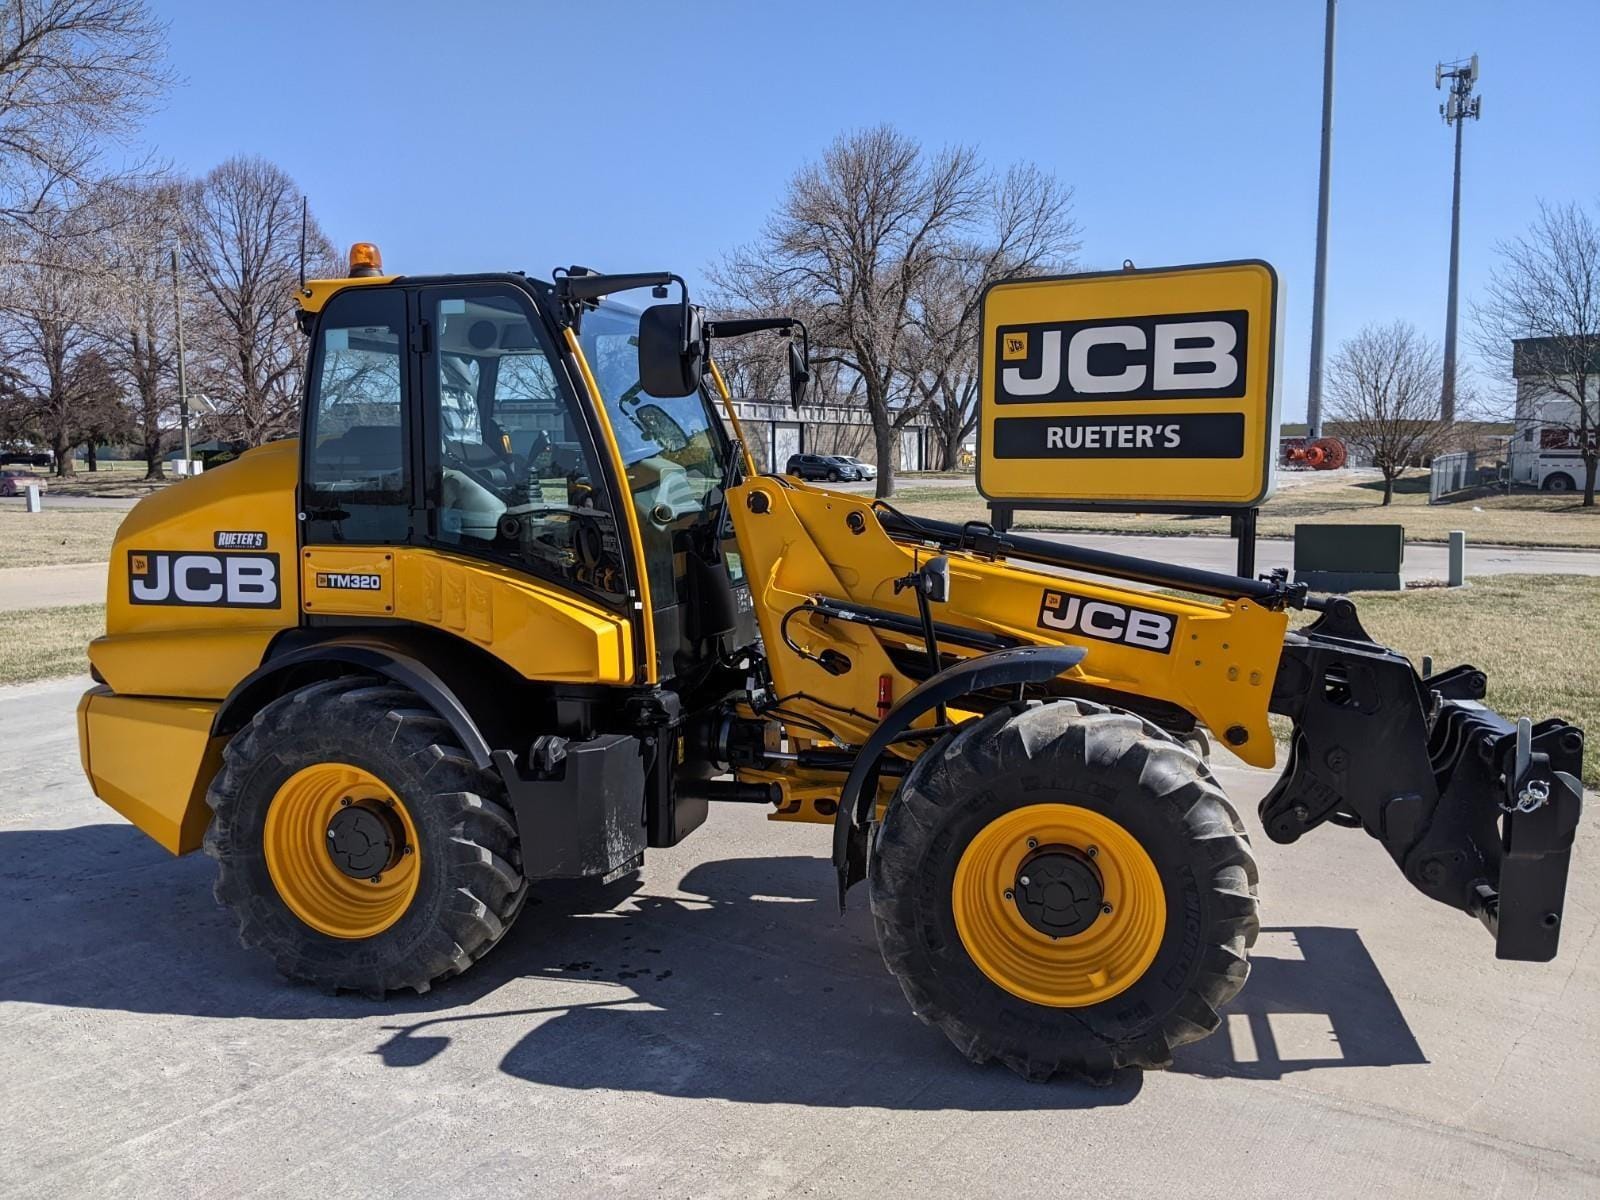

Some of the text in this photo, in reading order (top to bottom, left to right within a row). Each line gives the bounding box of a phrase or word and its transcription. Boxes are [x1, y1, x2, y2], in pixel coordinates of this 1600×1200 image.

[1003, 320, 1238, 396] JCB
[1047, 424, 1181, 449] RUETER'S
[218, 532, 263, 546] RUETER'S
[132, 555, 277, 603] JCB
[328, 574, 380, 589] TM320
[1042, 597, 1172, 649] JCB
